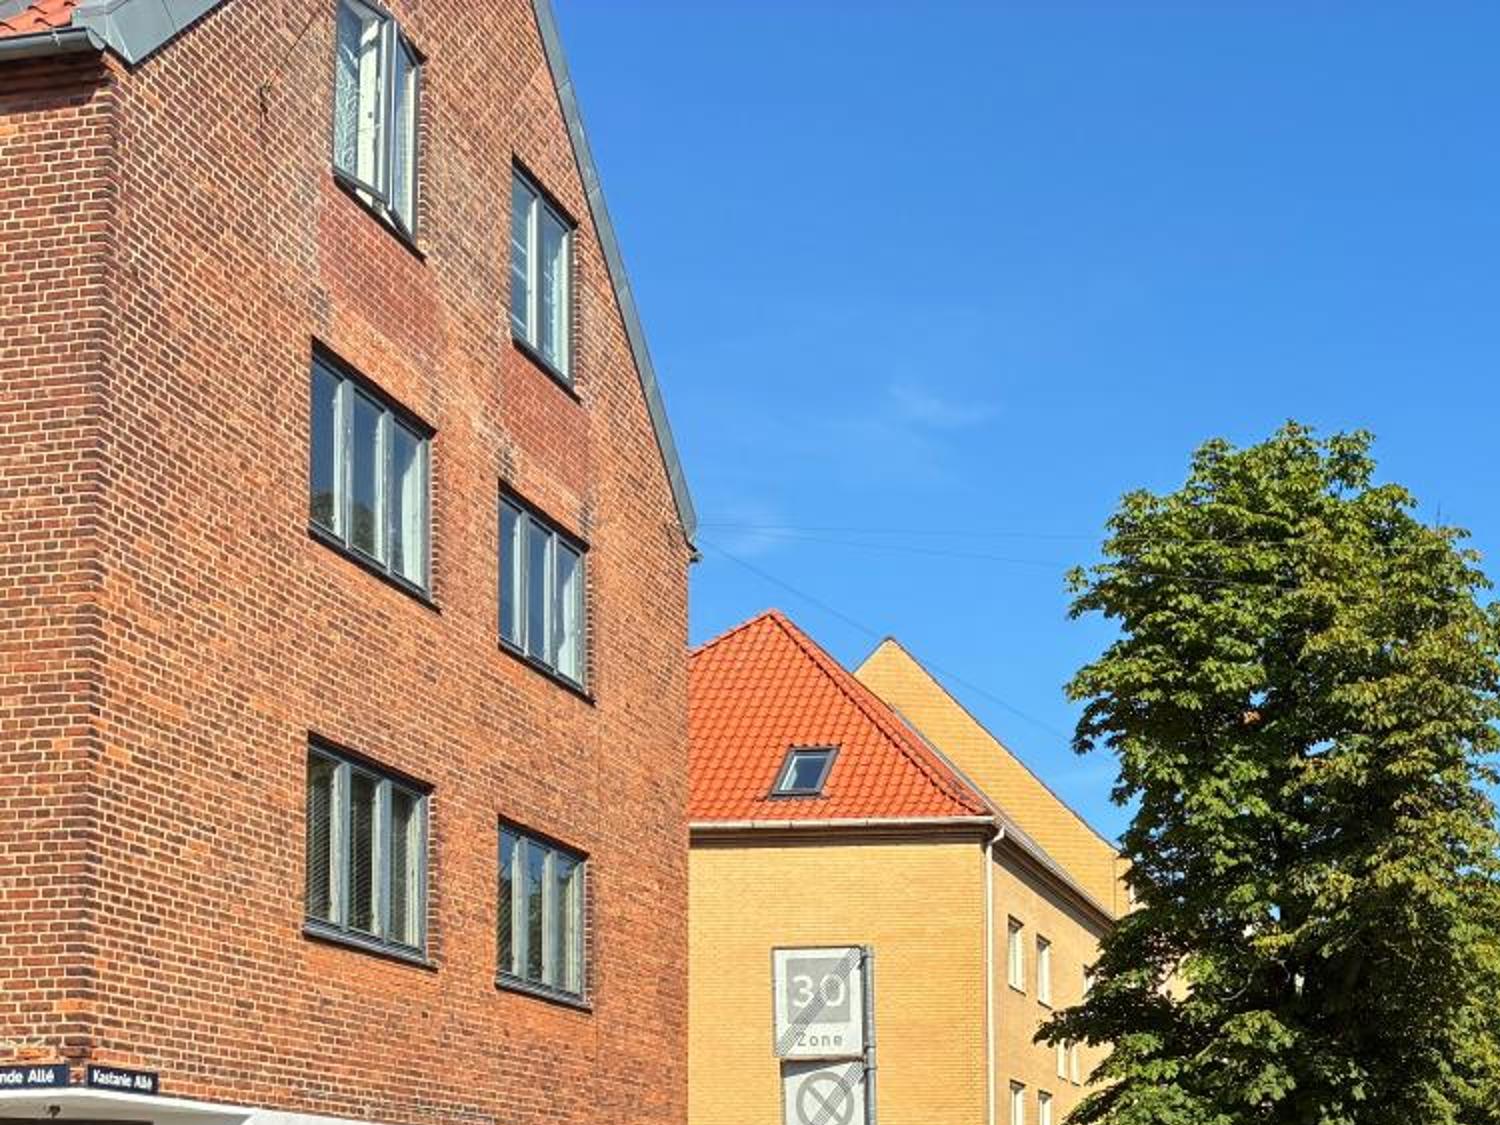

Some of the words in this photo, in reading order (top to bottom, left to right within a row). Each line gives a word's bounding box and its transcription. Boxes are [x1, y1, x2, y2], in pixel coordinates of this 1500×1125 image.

[793, 975, 845, 1007] 30
[797, 1032, 843, 1047] Zone
[93, 1069, 132, 1087] Kastanie
